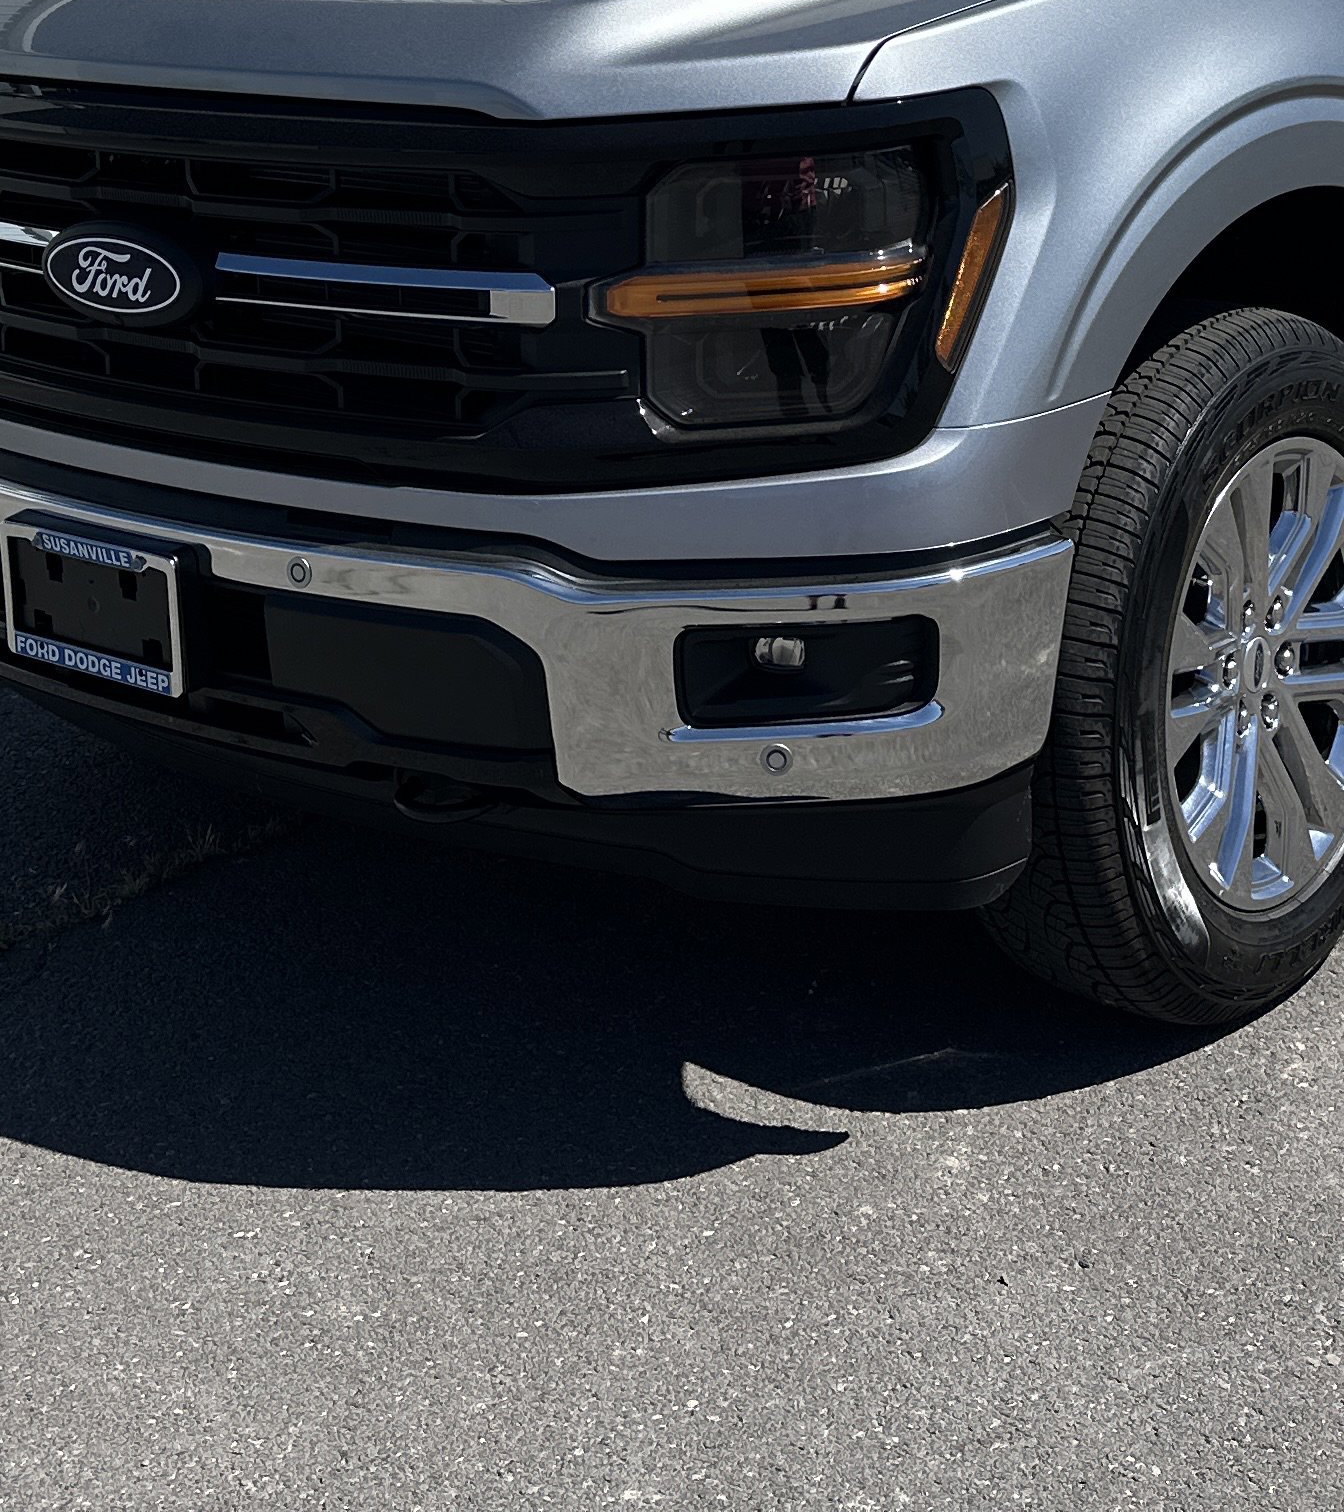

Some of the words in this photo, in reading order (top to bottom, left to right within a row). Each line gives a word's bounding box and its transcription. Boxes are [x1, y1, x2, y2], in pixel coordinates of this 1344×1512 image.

[72, 246, 152, 303] Ford
[42, 534, 131, 568] SUSANVILLE
[16, 636, 60, 662] FORD
[64, 648, 122, 679] DODGE
[127, 666, 169, 692] JEEP
